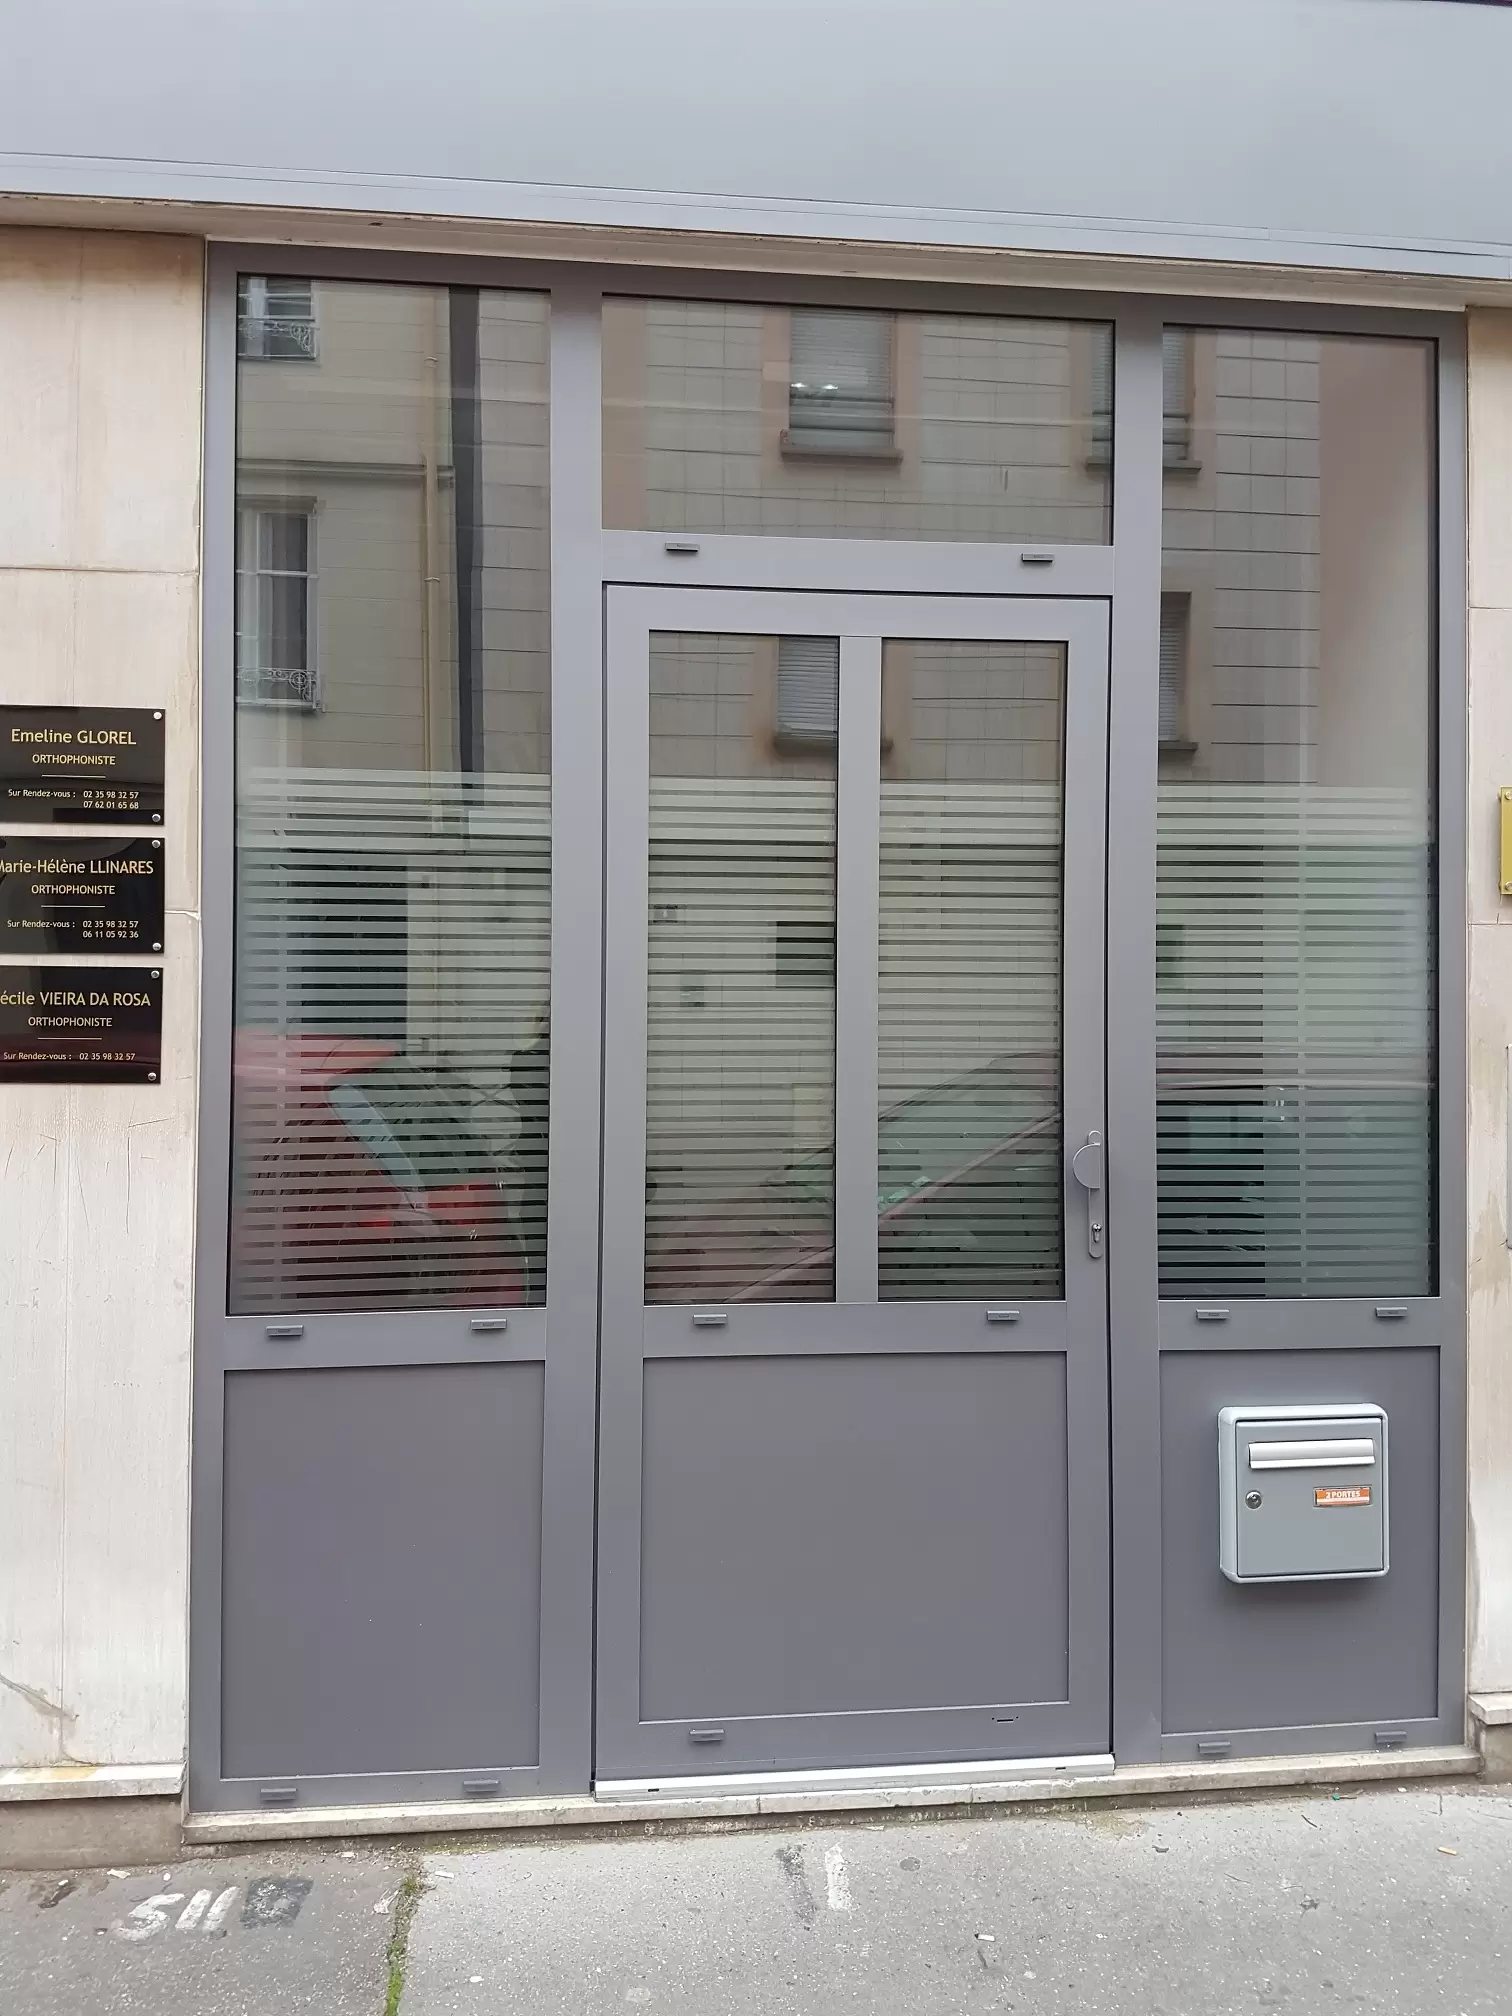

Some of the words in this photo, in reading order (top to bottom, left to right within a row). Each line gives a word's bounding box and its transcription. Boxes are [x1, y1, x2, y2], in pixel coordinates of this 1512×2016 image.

[11, 728, 72, 743] Emeline
[77, 730, 137, 745] GLOREL
[32, 754, 116, 765] ORTHOPHONISTE
[8, 789, 21, 797] Sur
[23, 789, 71, 798] Rendez-vous
[106, 791, 115, 799] 98
[90, 860, 153, 874] LLINARES
[31, 885, 115, 895] ORTHOPHONISTE
[7, 920, 20, 928] Sur
[22, 920, 70, 928] Rendez-vous
[0, 991, 35, 1005] écile
[40, 992, 86, 1005] VIEIRA
[90, 993, 109, 1006] DA
[113, 993, 151, 1006] ROSA
[28, 1017, 113, 1027] ORTHOPHONISTE
[4, 1052, 16, 1060] Sur
